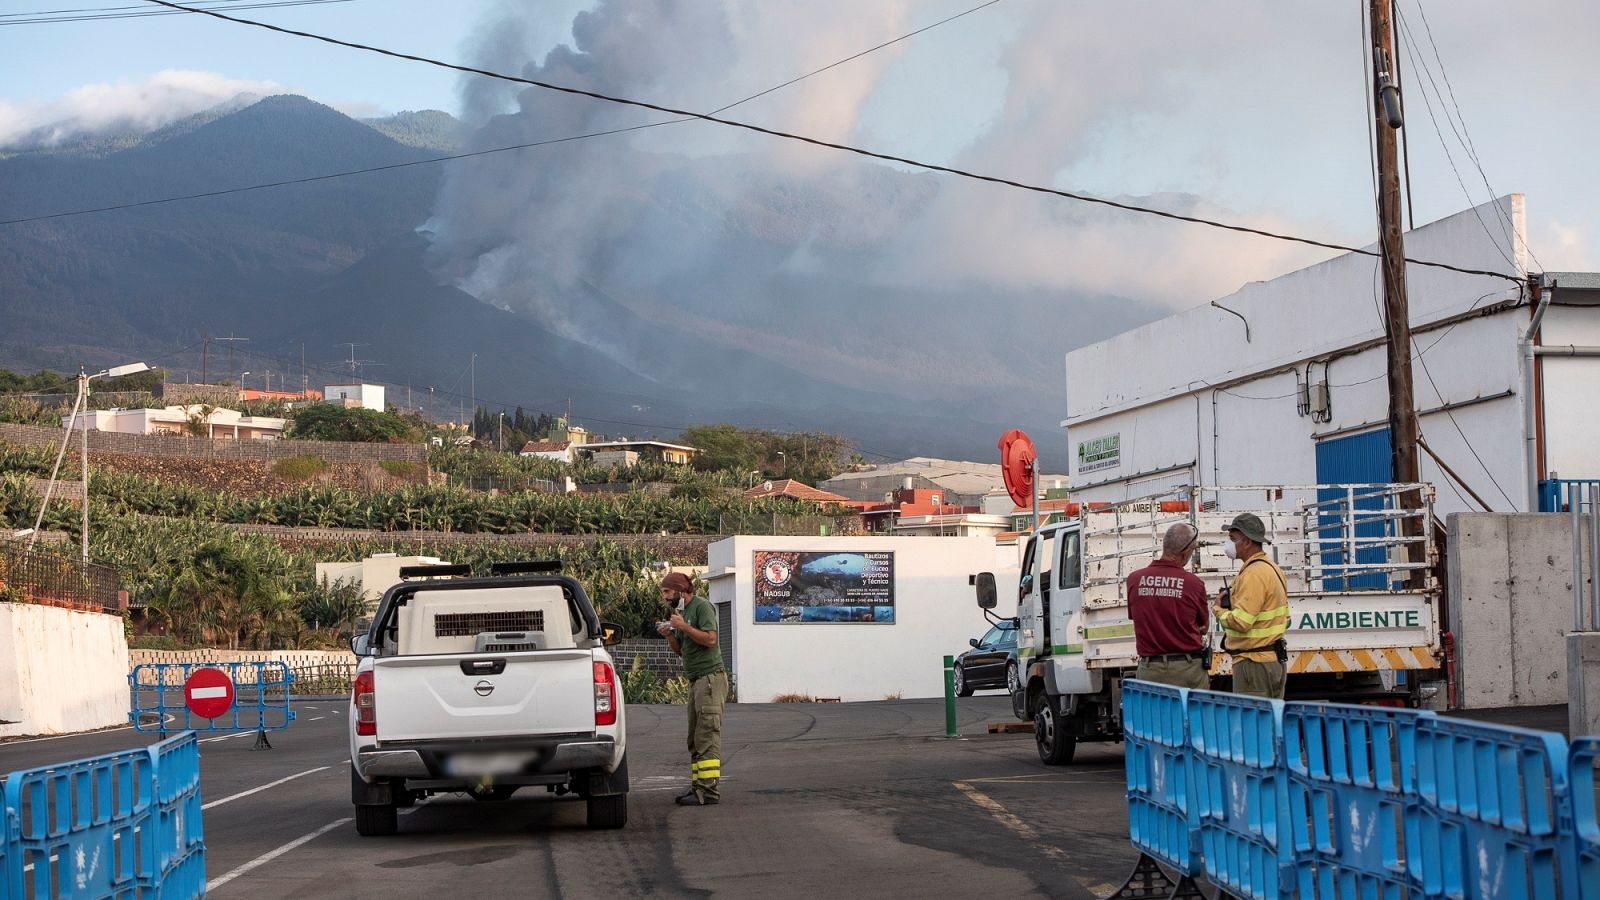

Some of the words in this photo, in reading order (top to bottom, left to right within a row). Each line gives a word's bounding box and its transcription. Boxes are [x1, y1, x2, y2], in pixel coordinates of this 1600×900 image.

[1140, 576, 1184, 589] AGENTE
[1138, 588, 1154, 596] MEDIO
[1155, 588, 1182, 598] AMBIENTE
[1299, 611, 1419, 629] AMBIENTE
